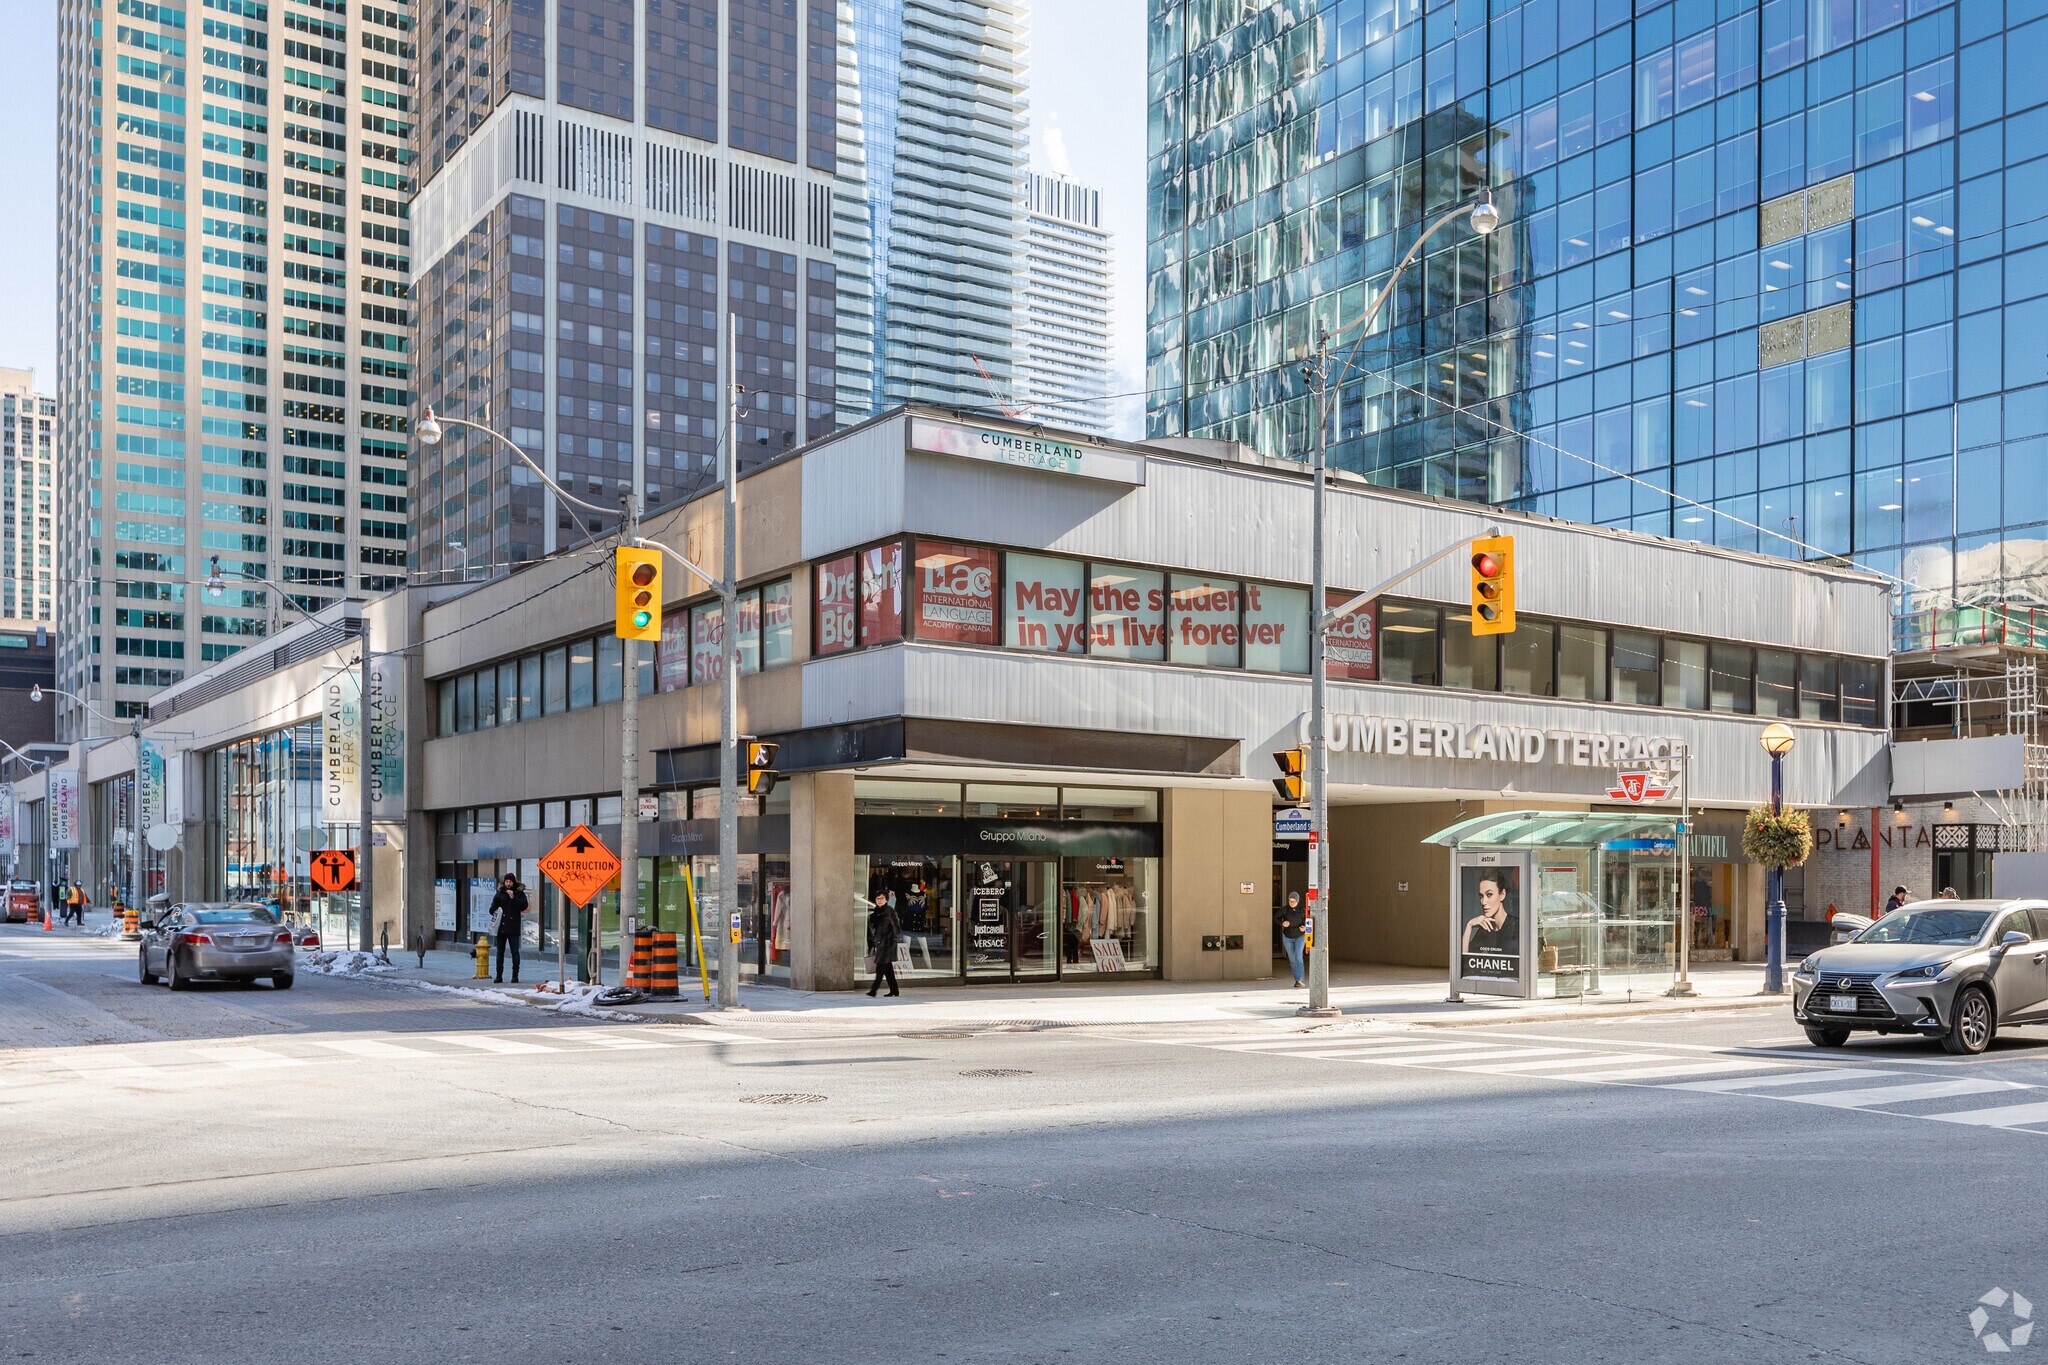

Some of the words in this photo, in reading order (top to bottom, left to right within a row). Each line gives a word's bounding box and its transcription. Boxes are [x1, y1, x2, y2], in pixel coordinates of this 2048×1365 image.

[981, 433, 1083, 460] CUMBERLAND
[999, 448, 1066, 470] TERRACE
[923, 594, 992, 609] INTERNATIONAL
[1015, 581, 1080, 617] May
[1090, 581, 1140, 612] the
[1148, 583, 1261, 612] student
[924, 606, 992, 623] LANGUAGE
[923, 621, 955, 631] ACADEMY
[962, 624, 991, 633] CANADA
[1018, 616, 1047, 646] in
[1057, 623, 1115, 651] you
[1123, 617, 1174, 646] live
[1181, 617, 1285, 645] forever
[330, 684, 341, 806] CUMBERLAND
[342, 705, 355, 785] TERRACE
[371, 671, 383, 802] CUMBERLAND
[384, 694, 397, 780] TERRACE
[1548, 729, 1686, 771] TERRACE
[1276, 822, 1307, 831] Cumberland
[980, 830, 1015, 843] Gruppo
[1017, 831, 1047, 841] Milano
[1816, 825, 1931, 850] PLANTA
[546, 860, 614, 870] CONSTRUCTION
[478, 878, 495, 889] Notice
[974, 939, 1004, 948] VERSACE
[1093, 942, 1121, 957] SALE
[1468, 957, 1514, 971] CHANEL
